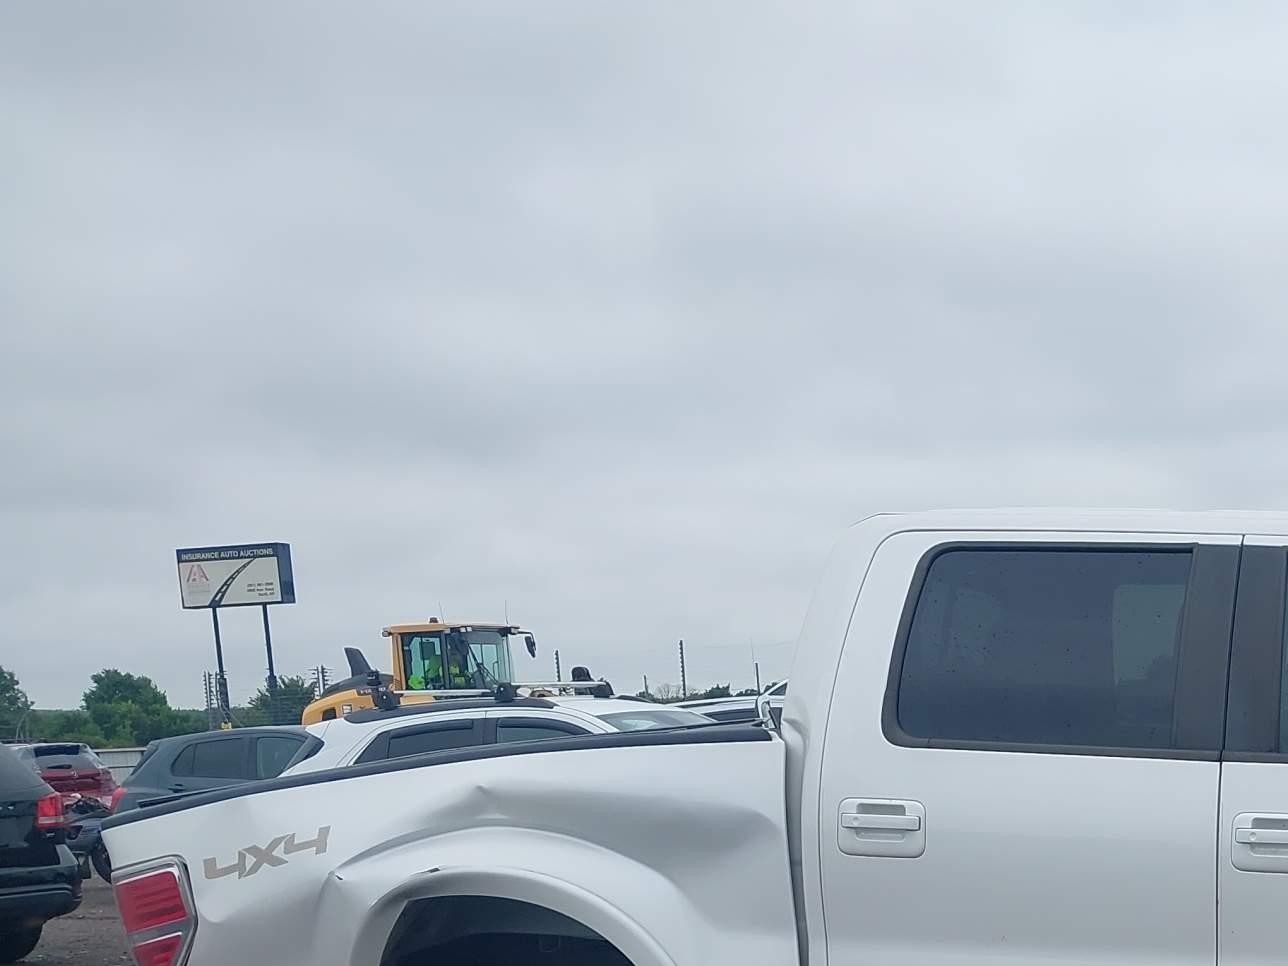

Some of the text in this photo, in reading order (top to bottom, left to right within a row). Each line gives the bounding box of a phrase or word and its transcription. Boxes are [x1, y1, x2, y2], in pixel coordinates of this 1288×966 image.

[181, 548, 273, 560] INSURANCE AUTO AUCTIONS
